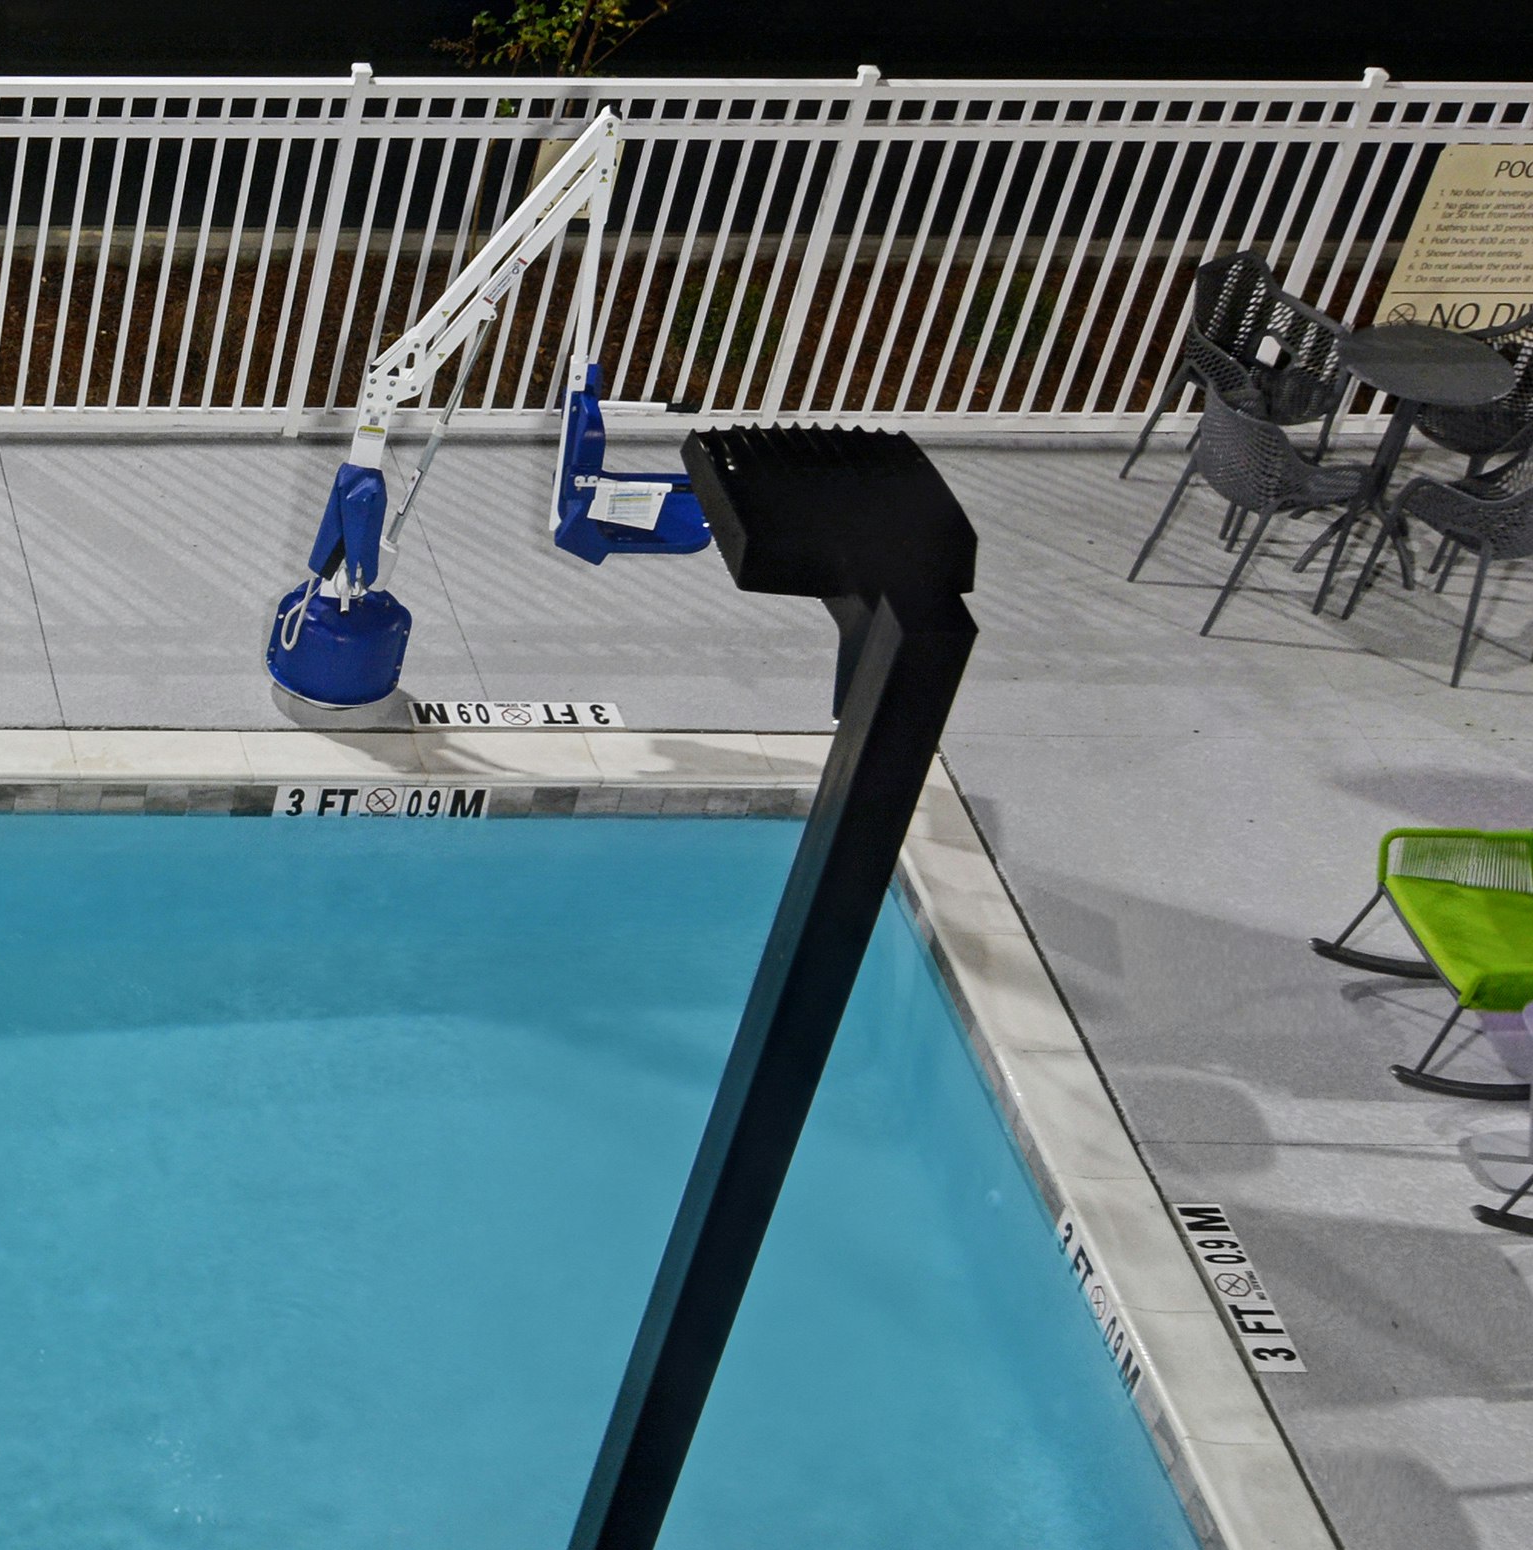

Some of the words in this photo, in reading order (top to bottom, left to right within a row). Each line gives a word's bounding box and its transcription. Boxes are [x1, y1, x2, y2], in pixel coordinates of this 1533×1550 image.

[1465, 188, 1486, 197] food
[1460, 202, 1479, 212] glass
[1487, 211, 1509, 219] from
[1436, 224, 1468, 233] Bathing
[1501, 263, 1521, 271] pool
[1415, 275, 1427, 283] Do
[1429, 275, 1444, 283] not
[1461, 275, 1481, 284] pool
[1490, 277, 1506, 285] you
[1427, 303, 1480, 329] NO
[413, 703, 451, 724] M
[457, 703, 490, 725] 0.9
[543, 704, 579, 724] FT
[589, 704, 610, 725] 3
[286, 788, 305, 817] 3
[317, 789, 359, 816] FT
[406, 790, 439, 817] 0.9
[448, 789, 486, 817] M
[1177, 1207, 1231, 1232] M
[1196, 1239, 1247, 1264] 0.9
[1058, 1222, 1073, 1255] 3
[1069, 1245, 1094, 1292] FT
[1118, 1348, 1141, 1399] M
[1228, 1304, 1285, 1335] FT
[1252, 1347, 1297, 1362] 3
